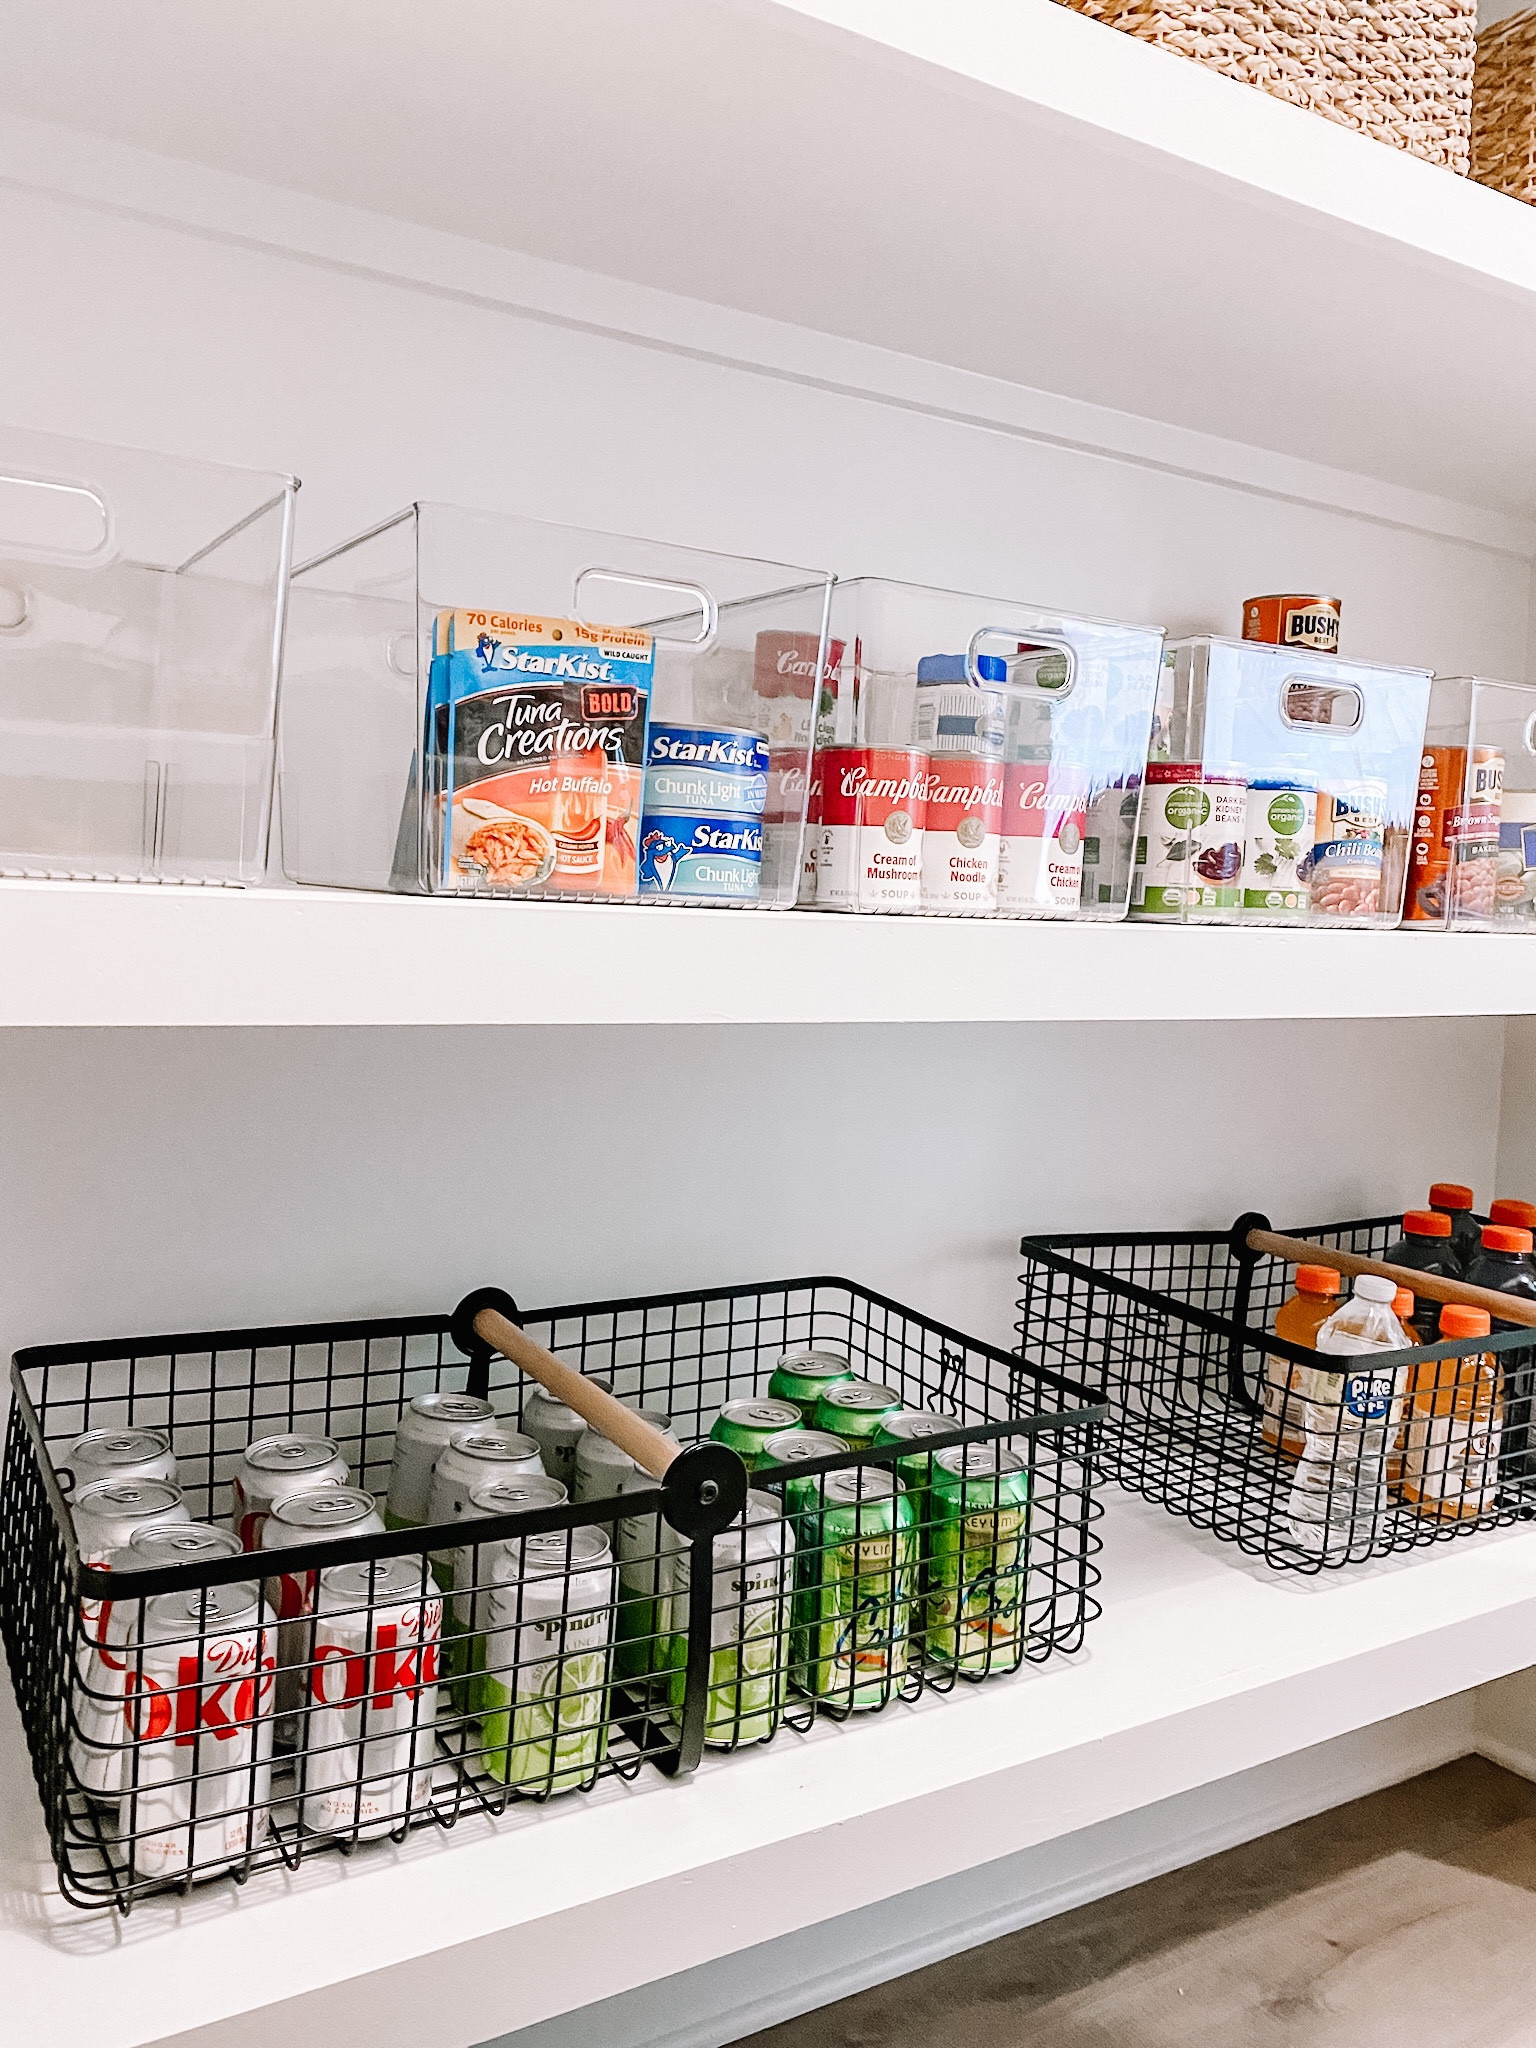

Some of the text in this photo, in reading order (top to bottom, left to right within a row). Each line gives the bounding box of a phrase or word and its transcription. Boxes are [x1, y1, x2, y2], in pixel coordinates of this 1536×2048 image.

[467, 612, 542, 634] 70 Calories
[575, 627, 599, 643] 15g
[500, 646, 613, 682] StarKist
[493, 694, 563, 725] Tuna
[589, 691, 632, 713] BOLD
[477, 718, 624, 765] Creations
[651, 737, 755, 768] StarKist
[529, 776, 612, 795] Hot Buffalo
[655, 777, 706, 796] Chunk
[710, 779, 742, 800] Light
[685, 792, 715, 806] TUNA
[1325, 840, 1363, 858] Chili
[873, 853, 907, 866] Cream
[949, 857, 989, 870] Chicken
[696, 866, 739, 881] Chunk
[950, 870, 987, 883] Noodle
[723, 882, 745, 892] TUNA
[881, 889, 909, 898] SOUP
[953, 891, 982, 901] SOUP
